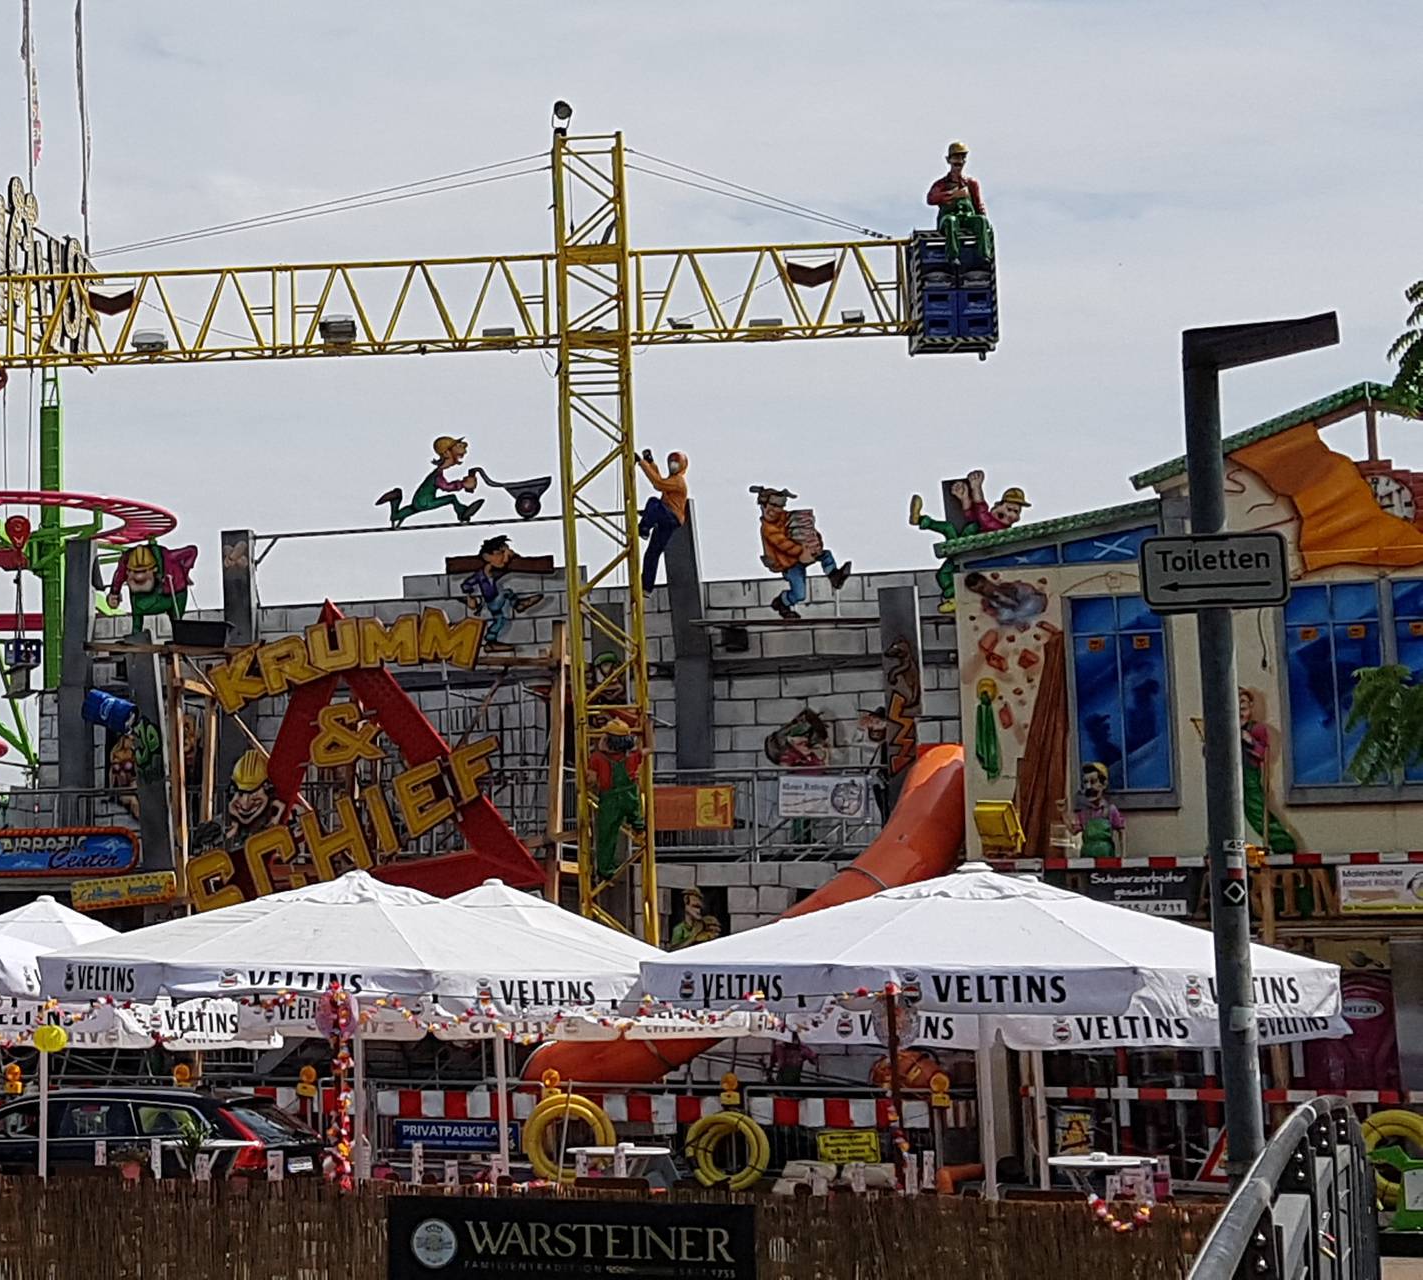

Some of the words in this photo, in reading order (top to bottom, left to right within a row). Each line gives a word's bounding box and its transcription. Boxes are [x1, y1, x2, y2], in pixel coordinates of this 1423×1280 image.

[1155, 549, 1270, 572] Toiletten
[209, 607, 487, 715] KRUMM
[309, 702, 384, 768] &
[186, 734, 502, 912] SCHIEF
[48, 848, 120, 869] Center
[1090, 871, 1187, 885] Schwarzarbeiter
[1114, 884, 1164, 900] gesucht!
[78, 965, 135, 993] VELTINS
[702, 973, 783, 1001] VELTINS
[932, 975, 1066, 1003] VELTINS
[499, 980, 596, 1006] VELTINS
[165, 1009, 239, 1034] VELTINS
[1075, 1016, 1189, 1040] VELTINS
[403, 1125, 513, 1138] PRIVATPARKPLAZ
[465, 1220, 735, 1263] WARSTEINER
